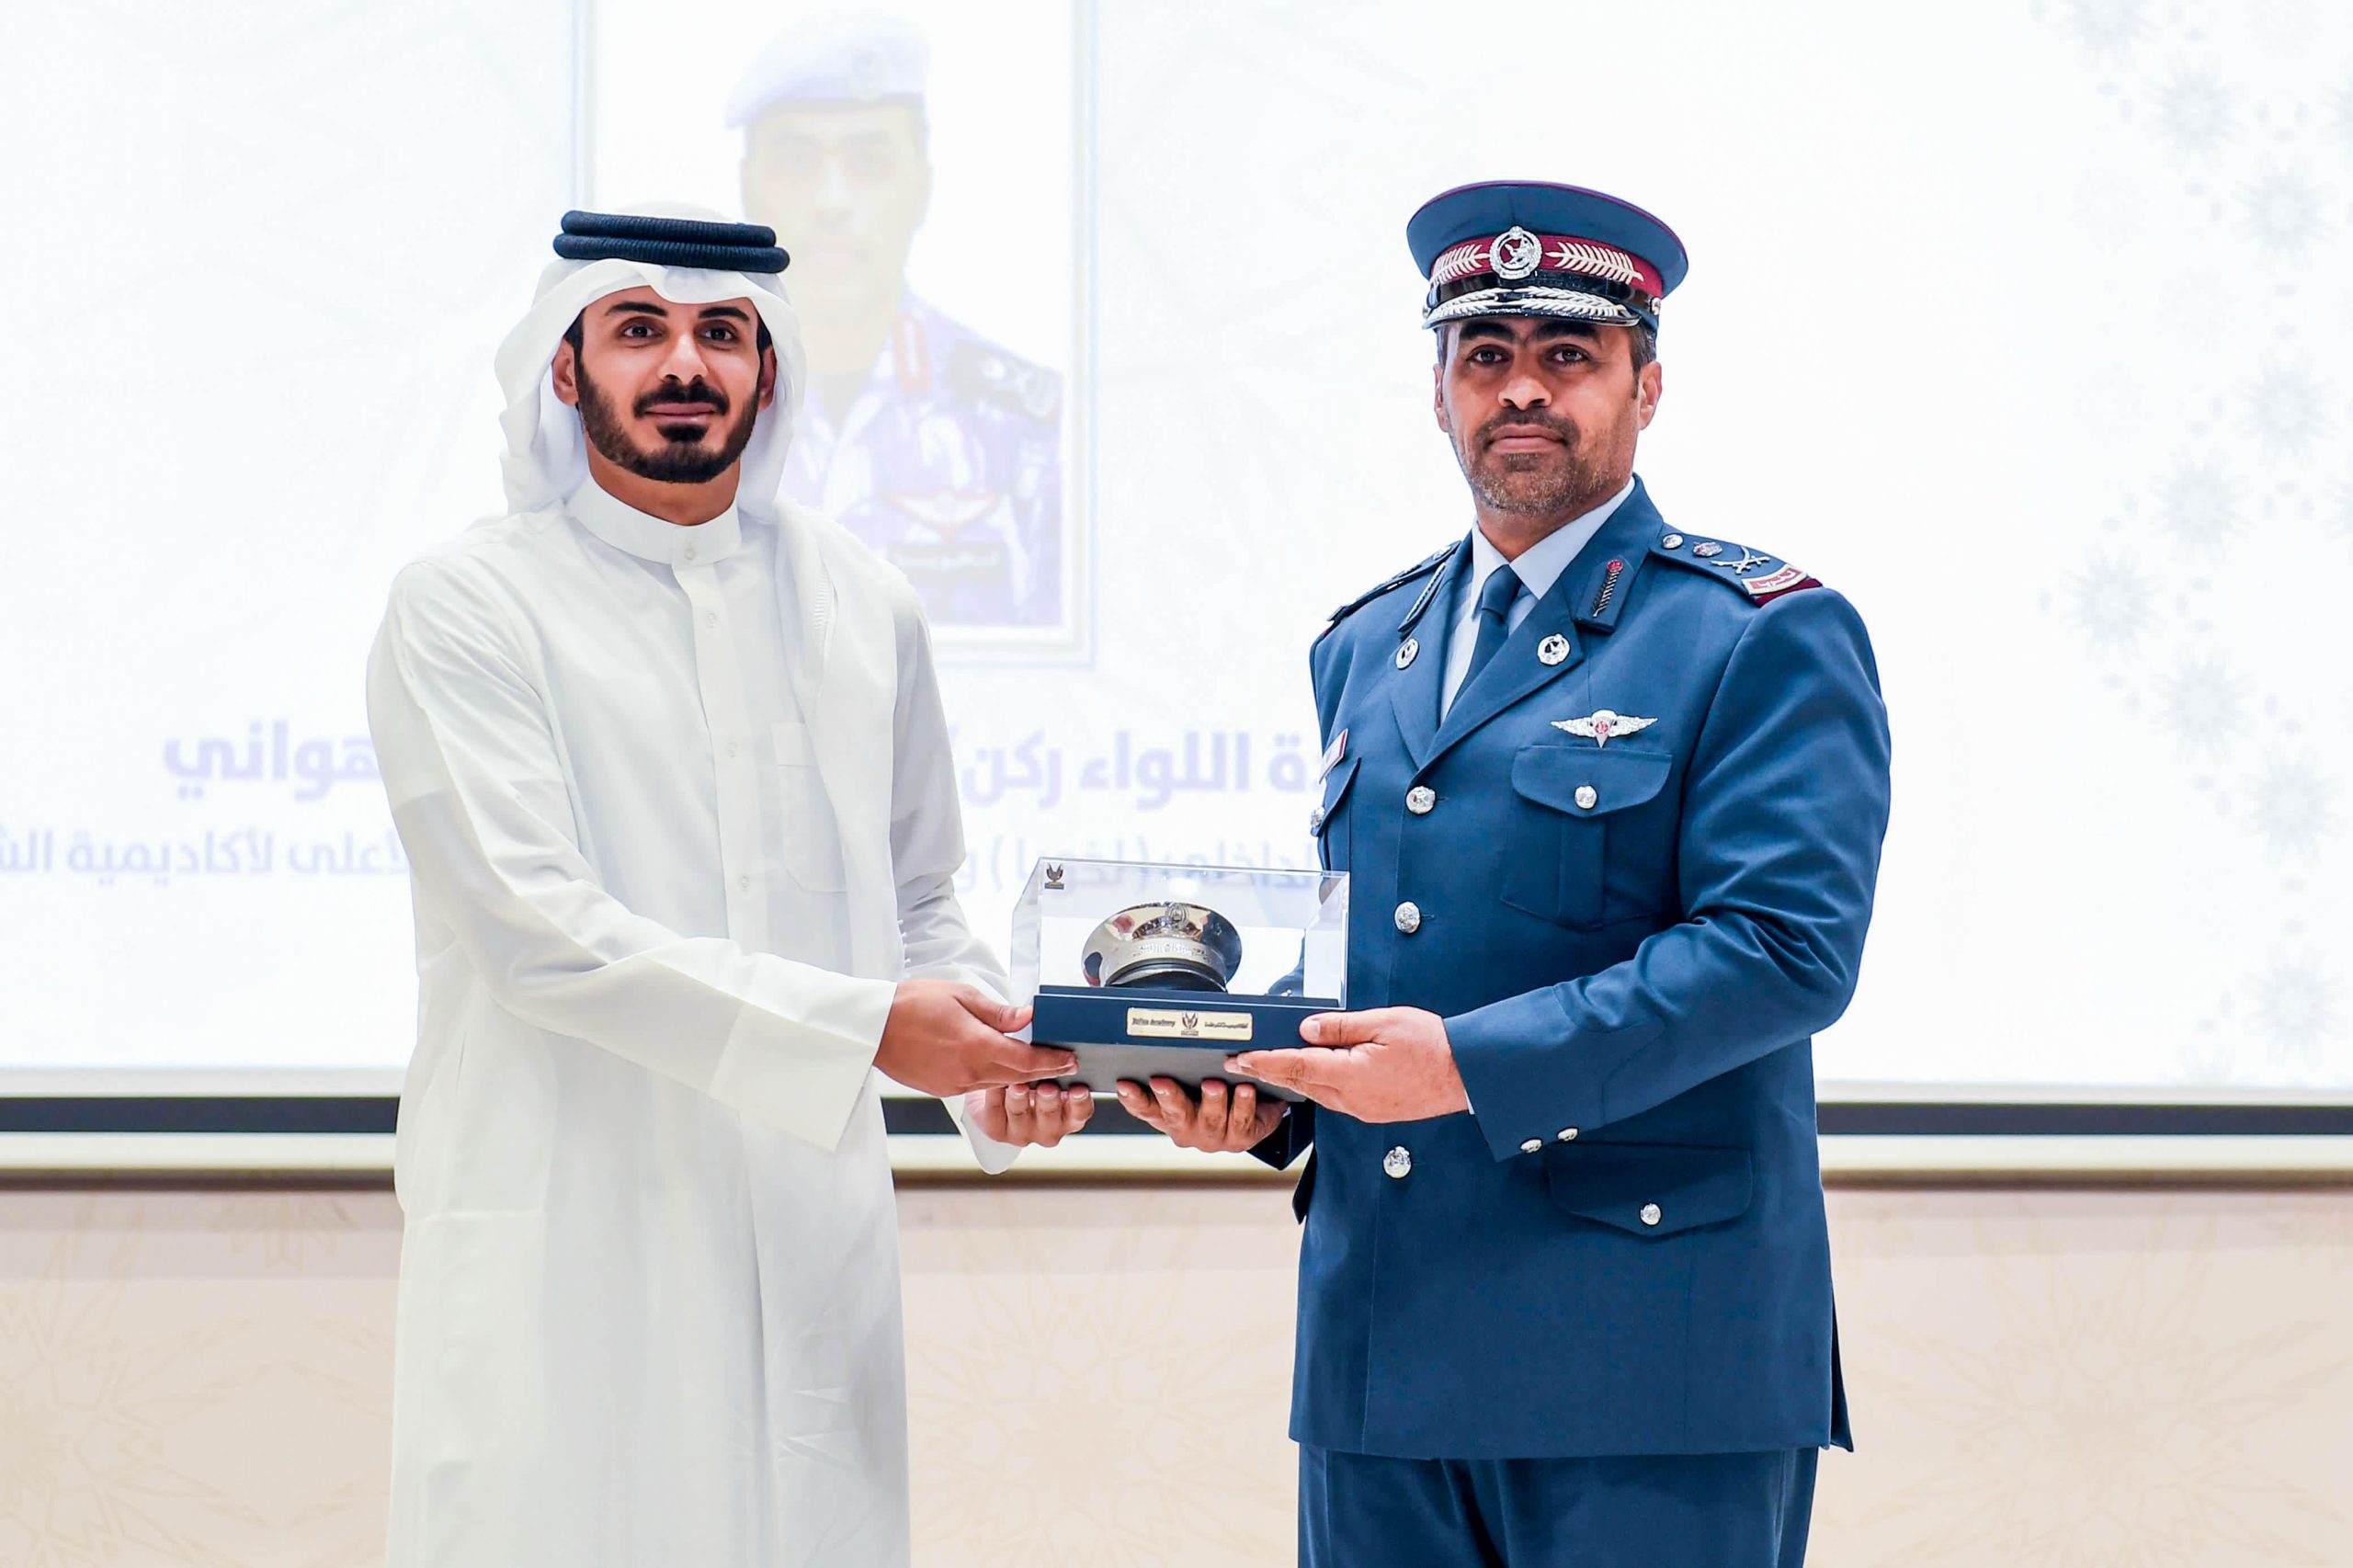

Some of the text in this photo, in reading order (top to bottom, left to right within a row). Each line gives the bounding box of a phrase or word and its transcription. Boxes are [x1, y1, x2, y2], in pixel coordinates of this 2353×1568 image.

[163, 718, 383, 803] هواني
[960, 727, 1063, 811] ركن
[1078, 728, 1252, 811] اللواء
